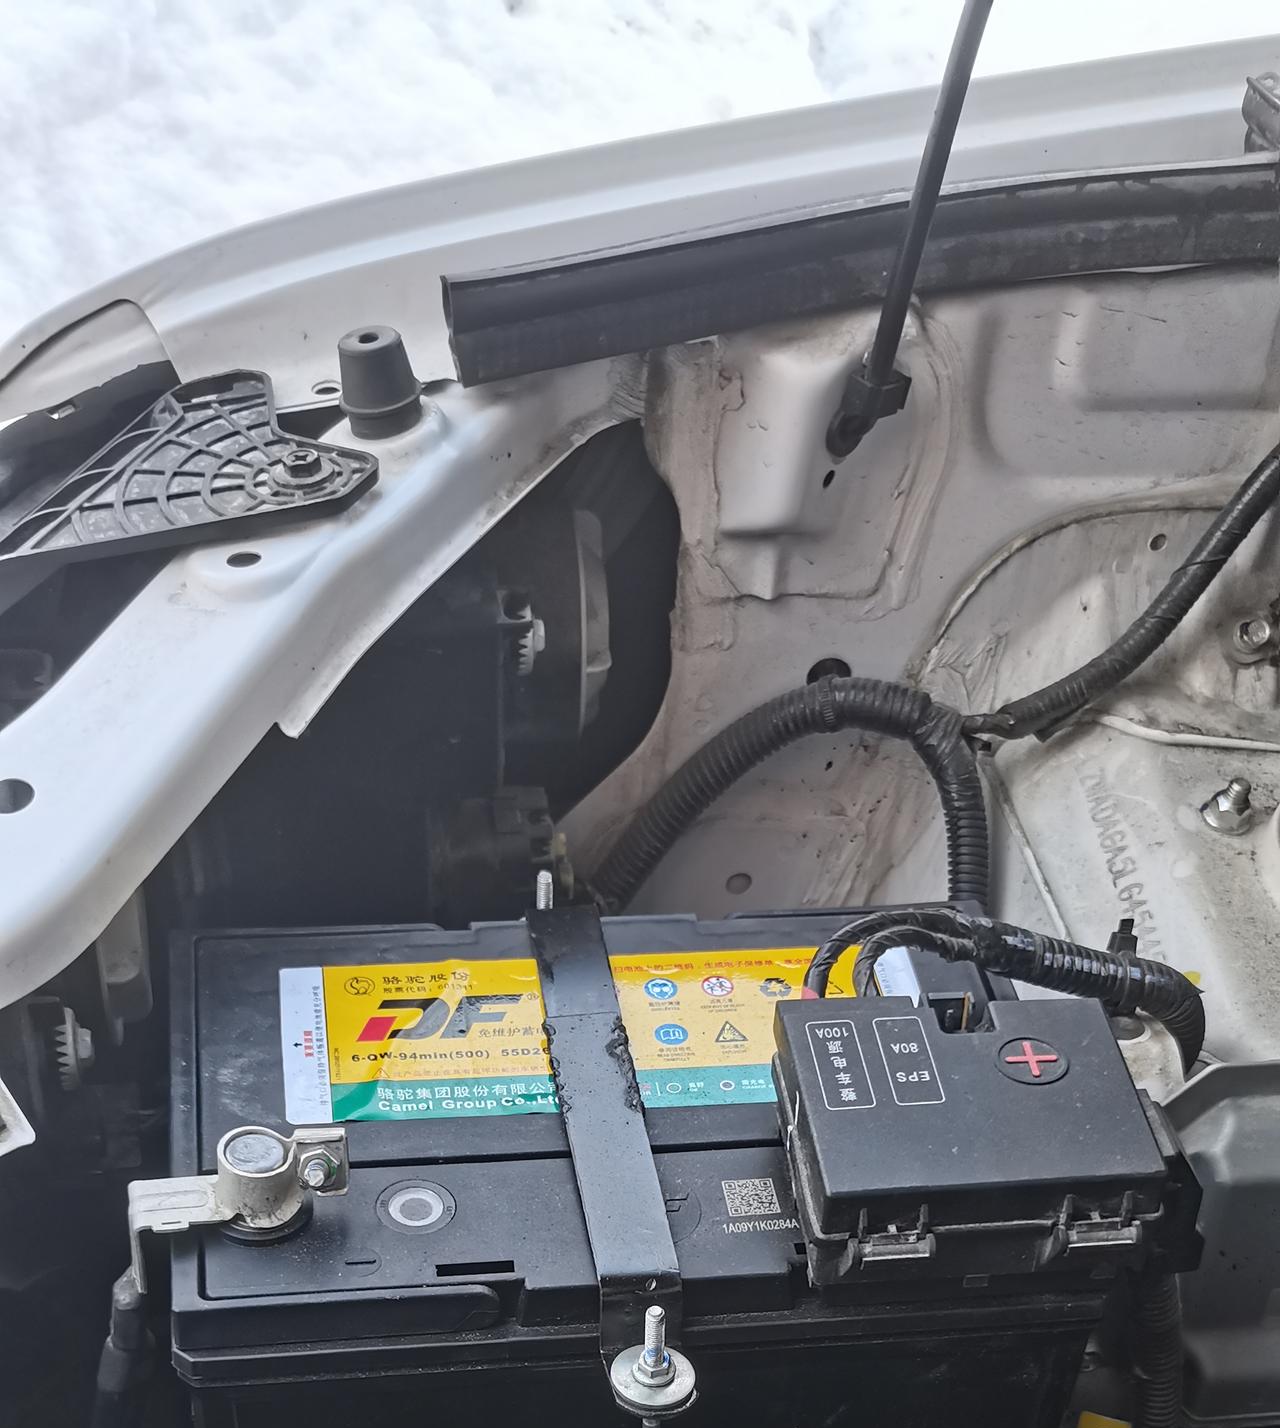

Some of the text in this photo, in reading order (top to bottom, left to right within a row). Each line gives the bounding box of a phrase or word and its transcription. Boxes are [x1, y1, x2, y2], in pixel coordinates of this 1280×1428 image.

[356, 994, 525, 1043] DF
[815, 1027, 850, 1040] 100A
[890, 1042, 919, 1054] 80A
[826, 1040, 857, 1102] 整车电源
[896, 1070, 931, 1083] EPS
[378, 1099, 434, 1112] Camel
[442, 1097, 497, 1110] Group
[722, 1218, 800, 1234] 1A09Y1K0284A
